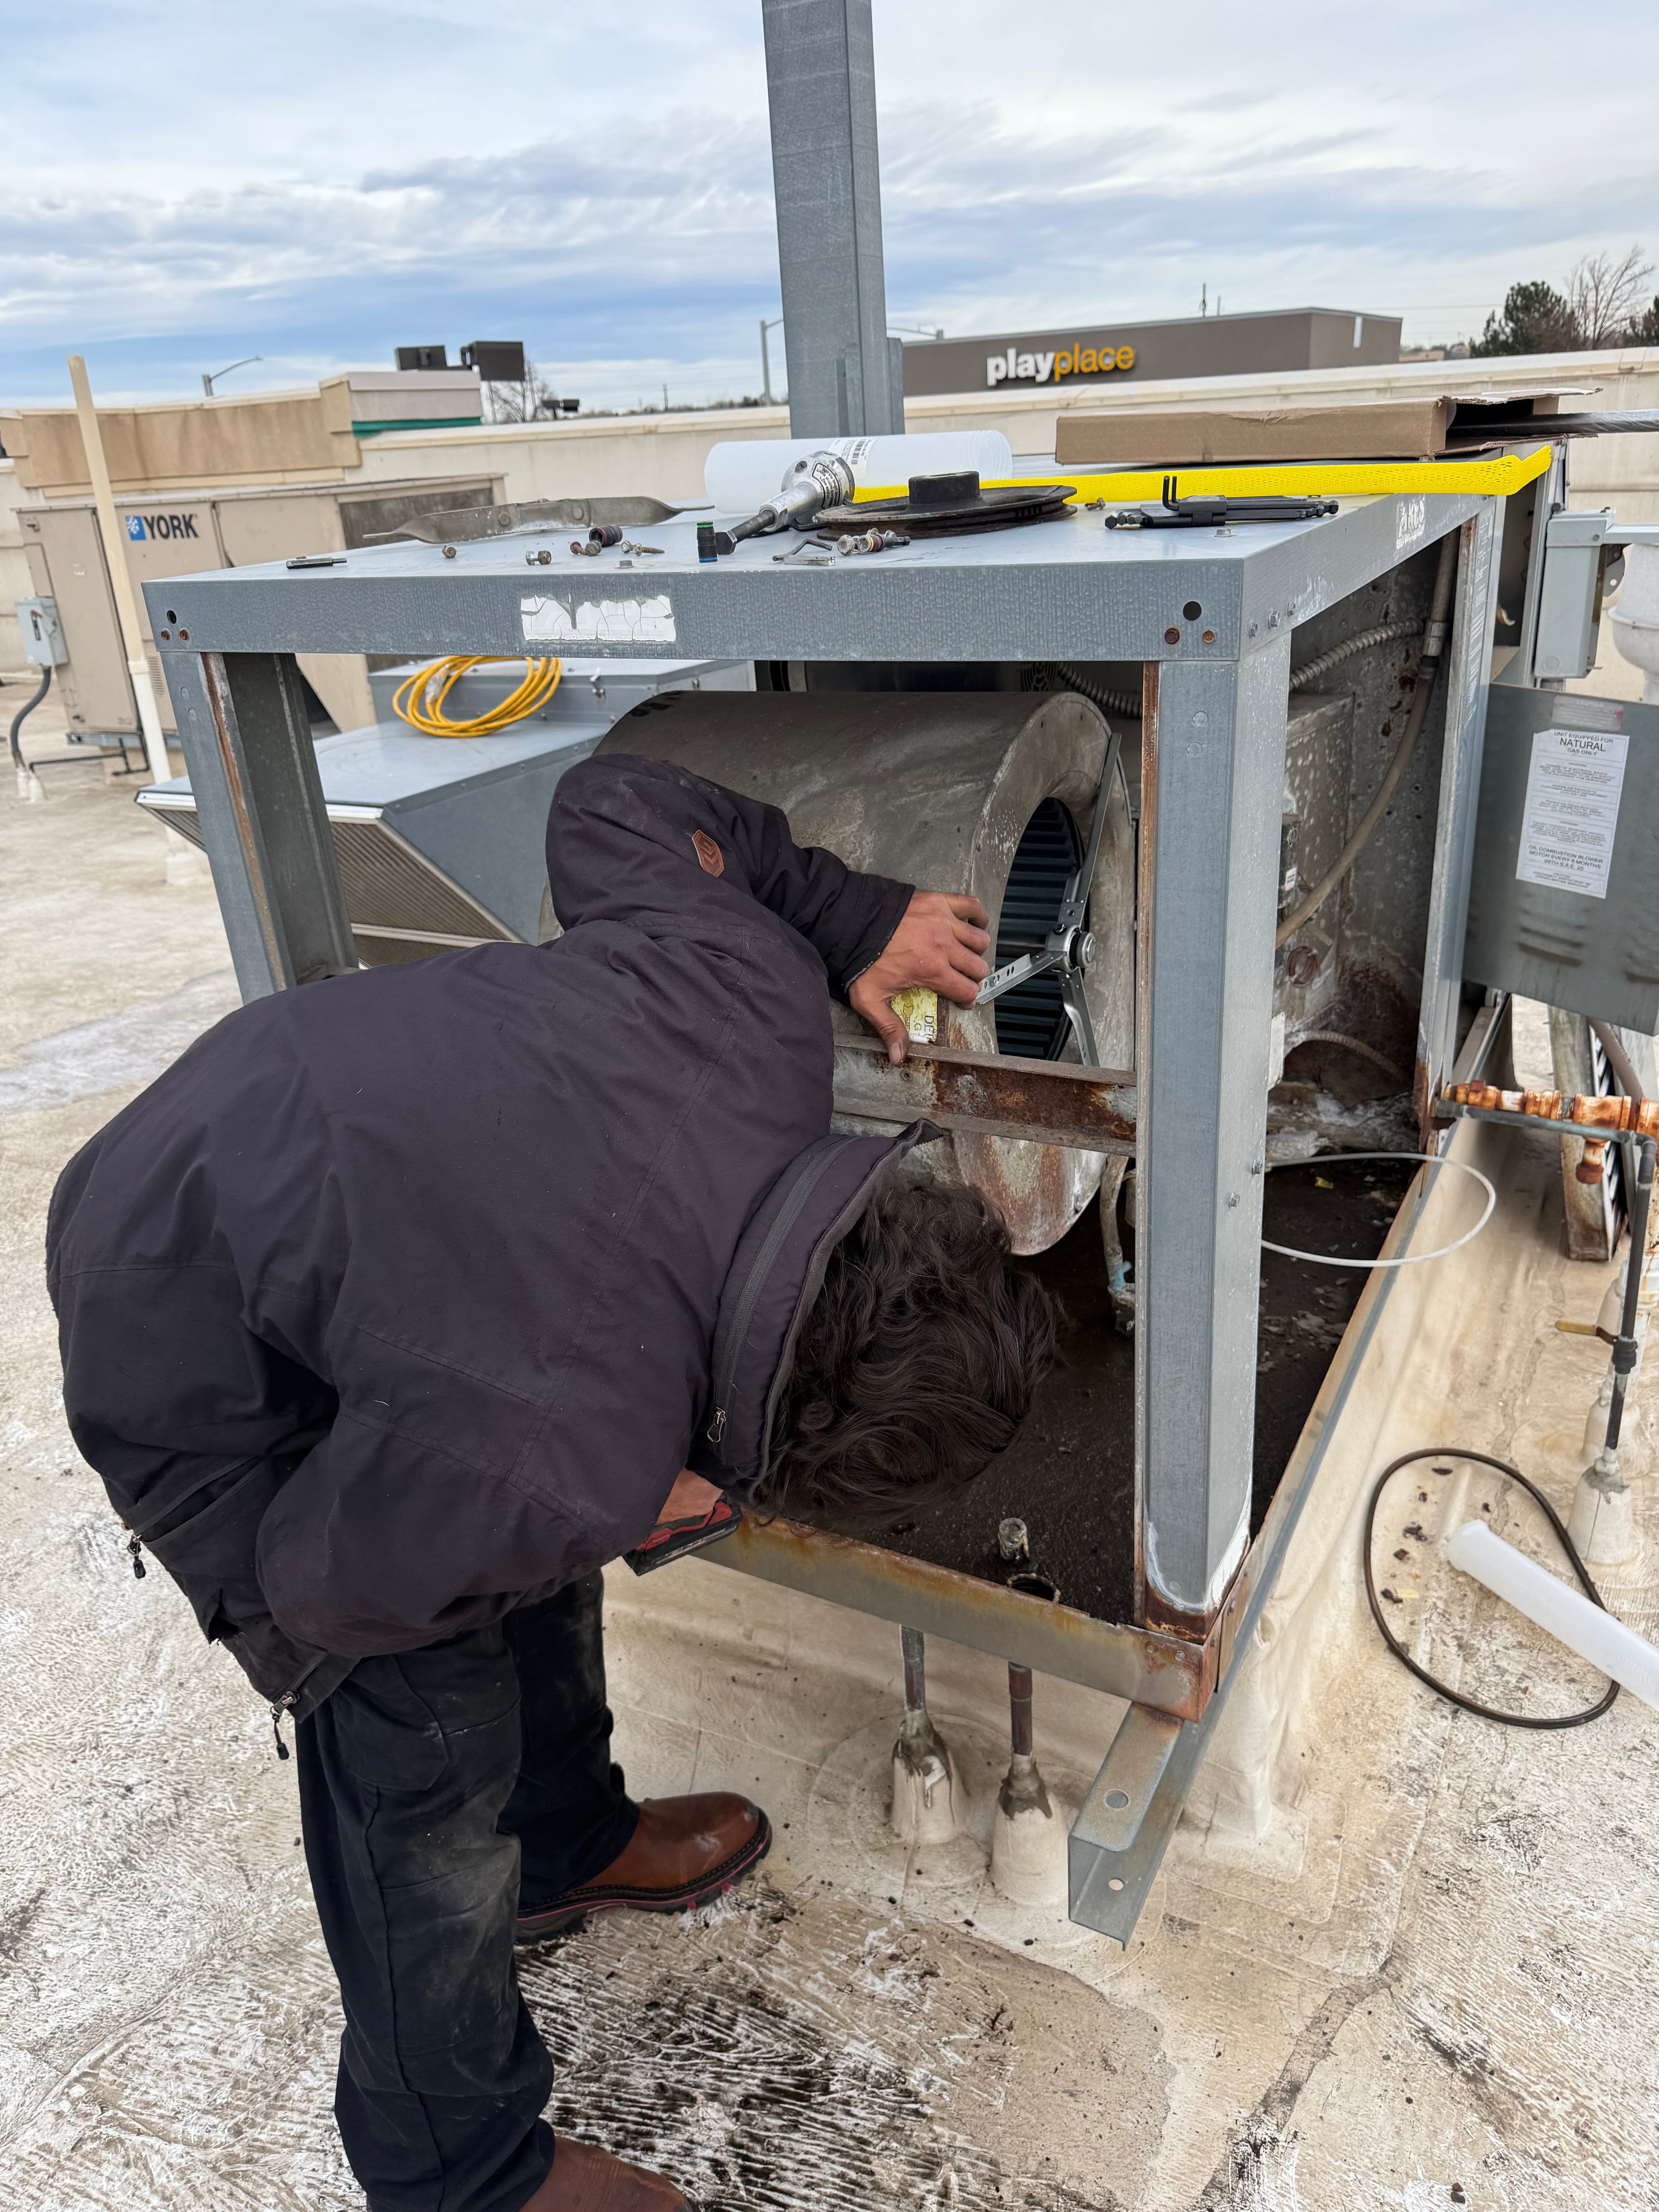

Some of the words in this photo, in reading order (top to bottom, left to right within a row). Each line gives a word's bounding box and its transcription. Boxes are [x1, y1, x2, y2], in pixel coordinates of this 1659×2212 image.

[987, 343, 1134, 386] playplace
[143, 514, 199, 539] YORK
[1560, 737, 1605, 752] NATURAL
[1539, 846, 1577, 859] COMBUSTION
[1578, 855, 1603, 864] BLOWER
[1551, 855, 1570, 863] EVERY
[1576, 859, 1601, 869] MONTHS
